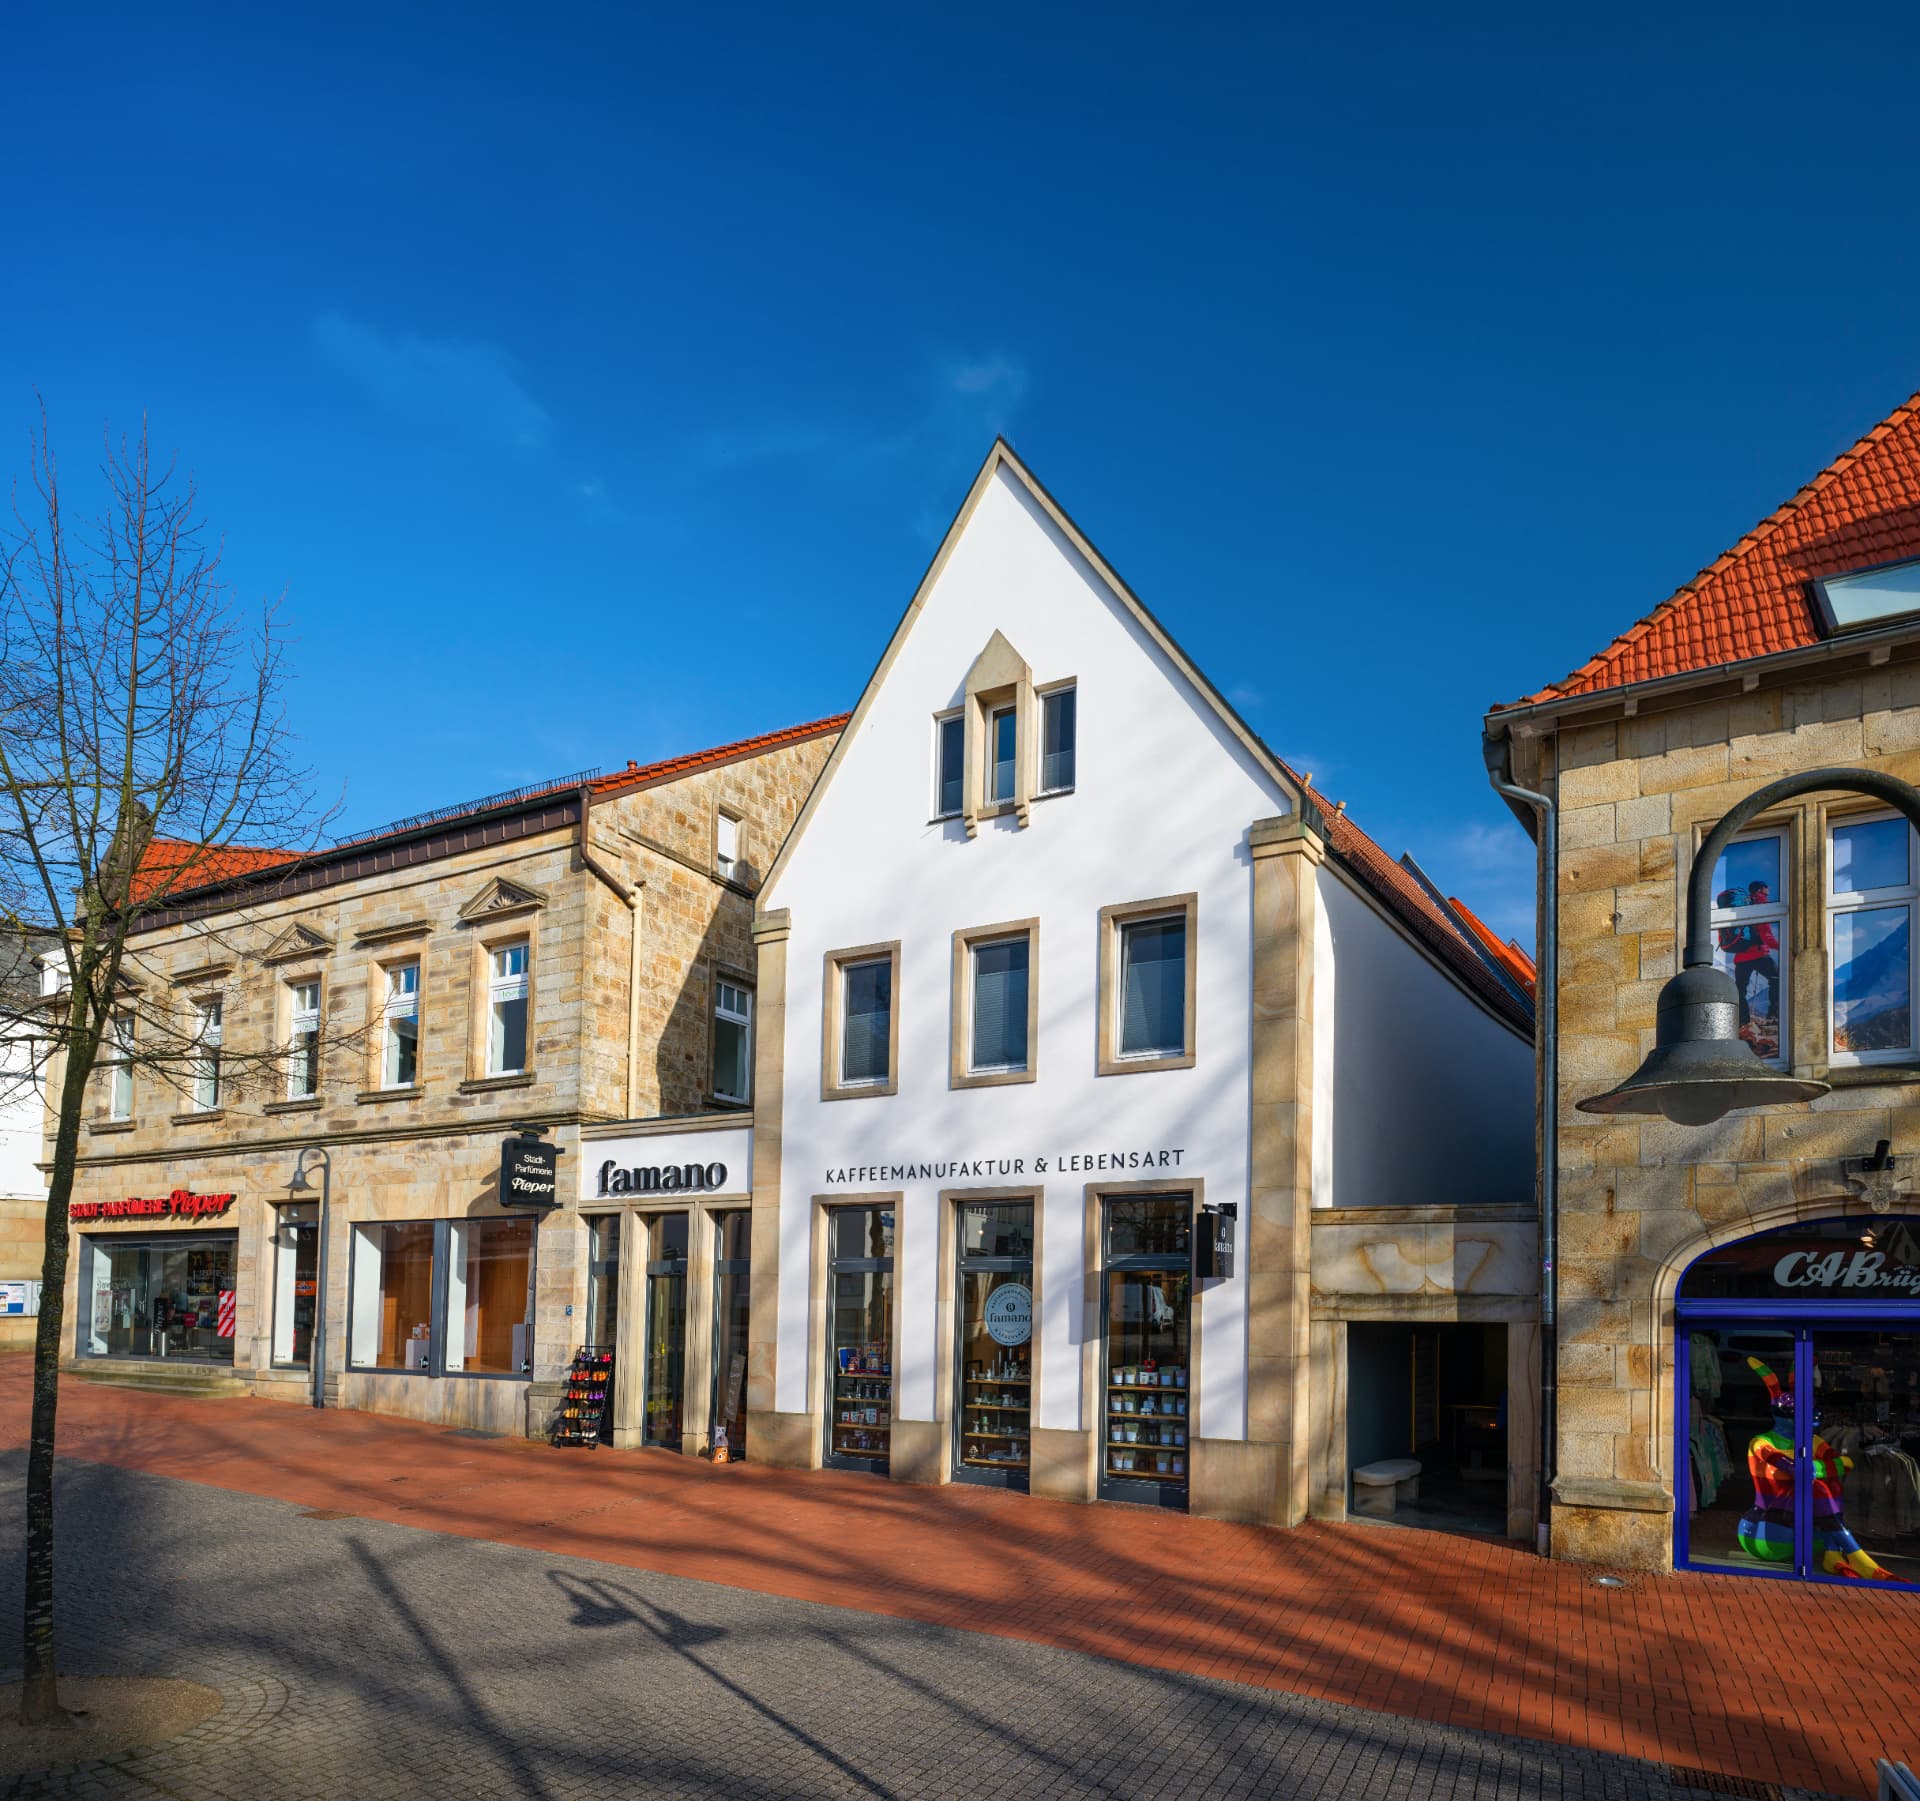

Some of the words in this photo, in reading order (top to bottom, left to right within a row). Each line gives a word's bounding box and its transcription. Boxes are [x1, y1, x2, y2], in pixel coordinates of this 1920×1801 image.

[515, 1163, 553, 1176] Parfümerie
[523, 1154, 546, 1164] Stadt-
[826, 1159, 1025, 1183] KAFFEEMANUFAKTUR
[1034, 1157, 1048, 1173] &
[1058, 1150, 1184, 1172] LEBENSART
[511, 1177, 555, 1193] Pieper
[599, 1159, 728, 1193] famano
[169, 1189, 231, 1217] Pieper
